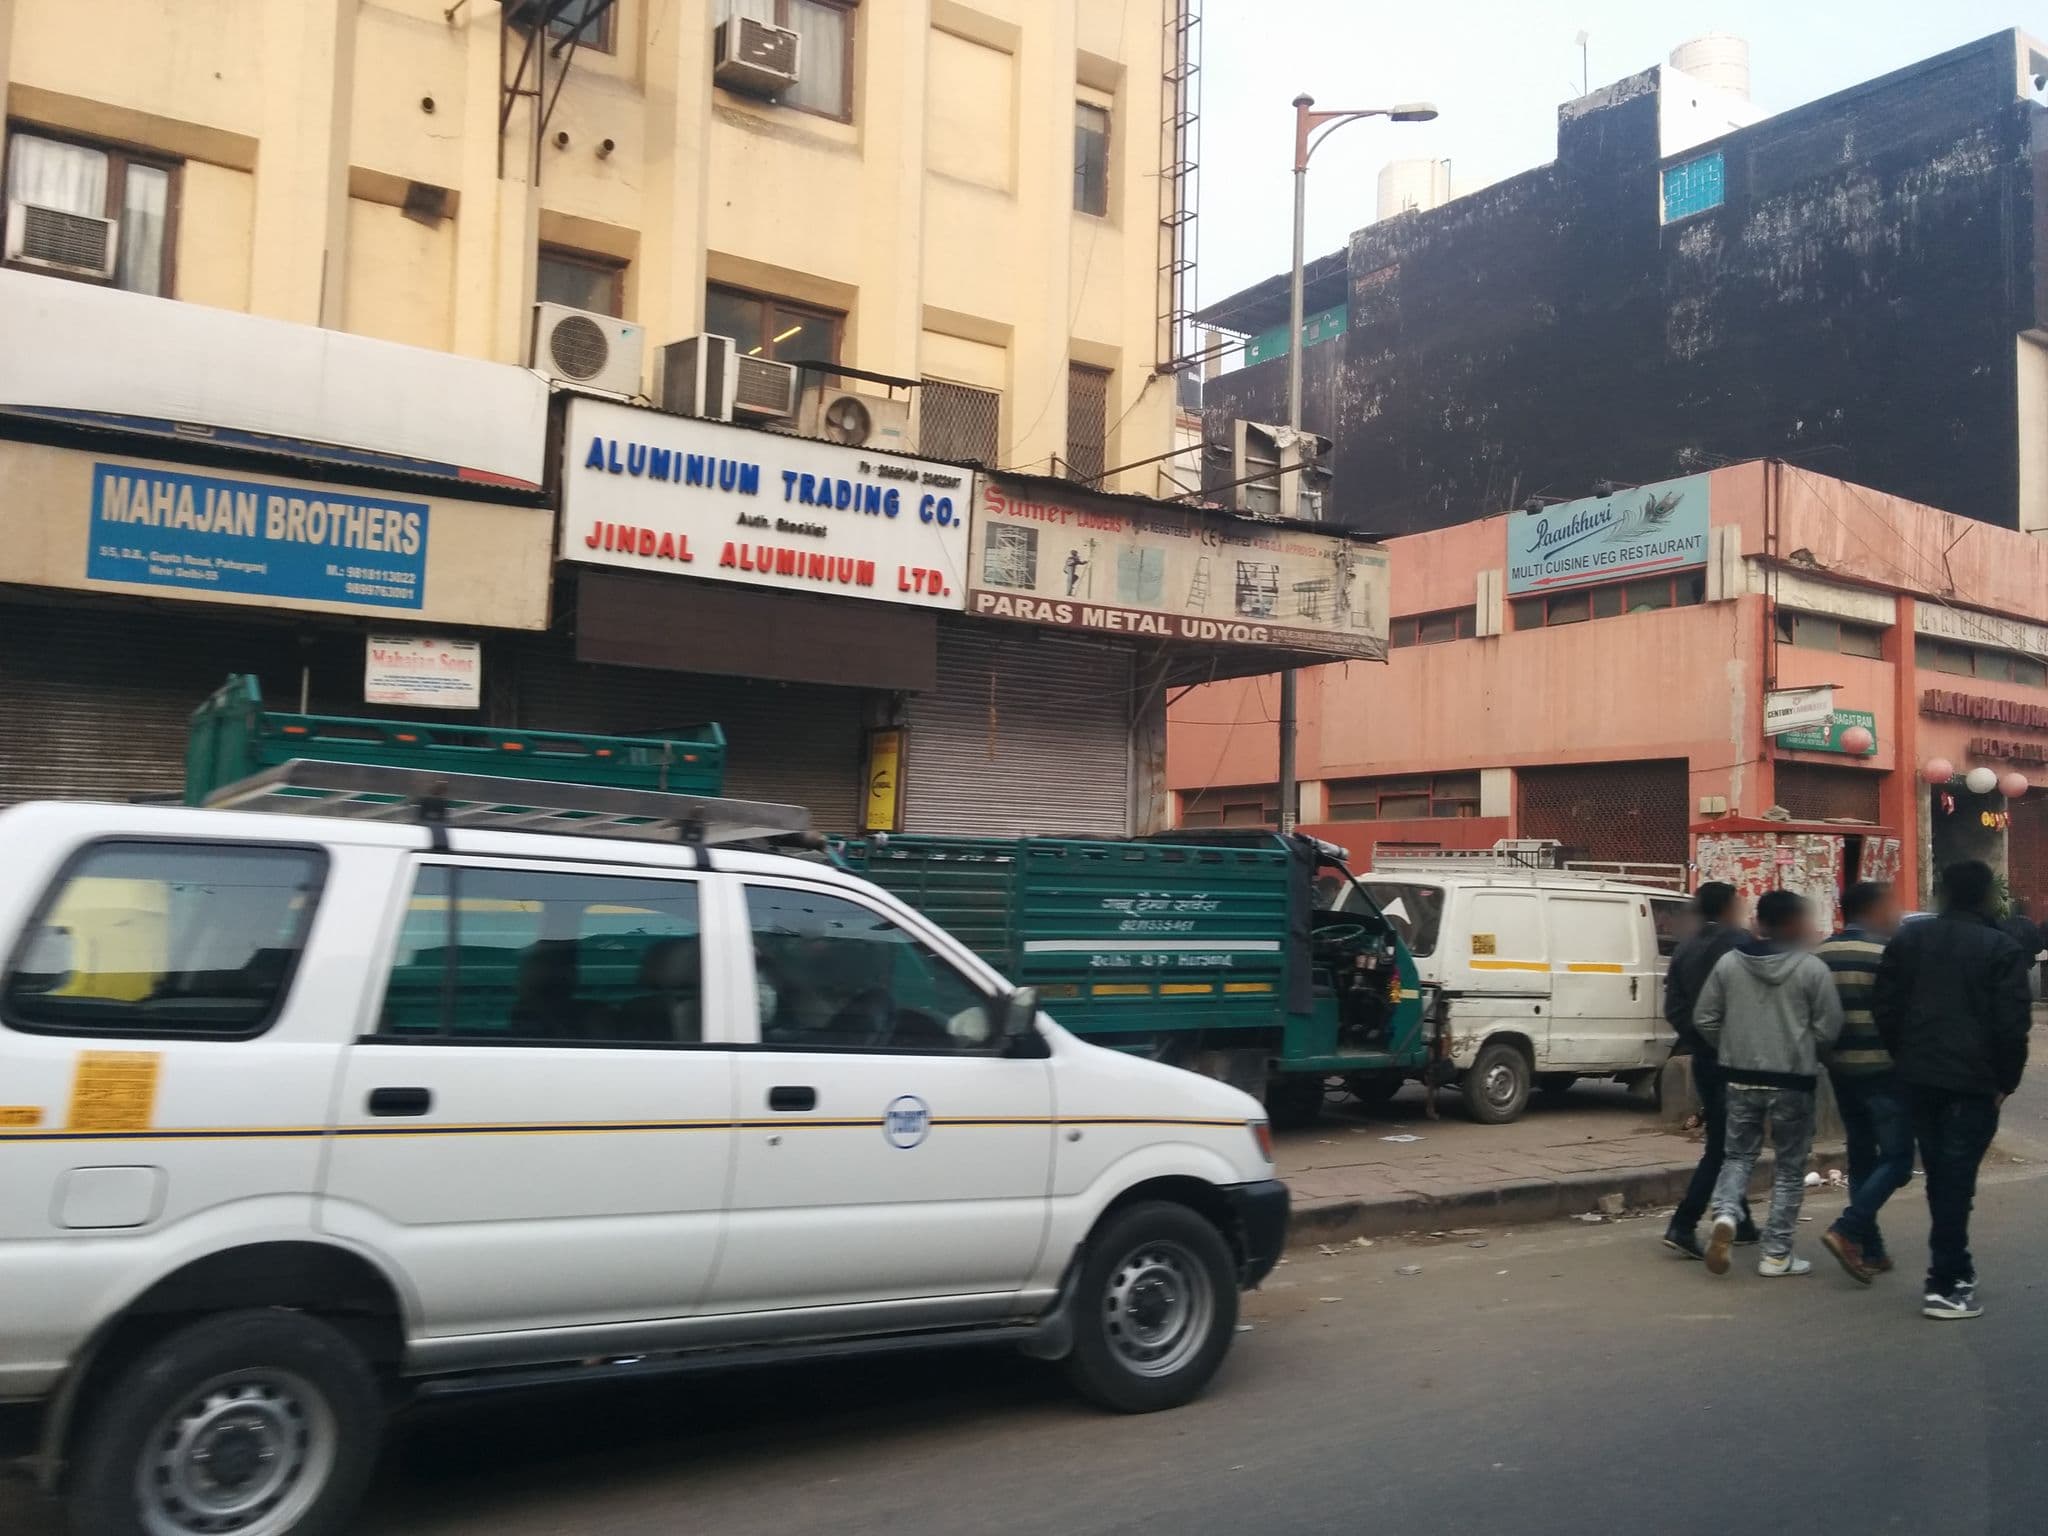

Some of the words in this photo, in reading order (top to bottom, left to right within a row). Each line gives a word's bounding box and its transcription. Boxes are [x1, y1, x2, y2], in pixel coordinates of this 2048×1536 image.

[585, 436, 760, 496] ALUMINIUM
[782, 469, 900, 518] TRADING
[919, 493, 961, 528] CO.
[101, 475, 257, 538] MAHAJAN
[265, 495, 421, 556] BROTHERS
[983, 484, 1074, 525] Sumer
[1078, 510, 1122, 534] LADDERS
[1526, 502, 1614, 552] Paankhuri
[585, 520, 694, 562] JINDAL
[719, 541, 876, 587] ALUMINIUM
[897, 565, 952, 597] LTD.
[1511, 563, 1543, 580] MULTI
[1545, 555, 1589, 574] CUISINE
[1592, 549, 1616, 566] VEG
[1620, 535, 1702, 561] RESTAURANT
[976, 593, 1074, 625] PARAS
[1082, 605, 1174, 636] METAL
[1181, 618, 1268, 643] UDYOG
[1767, 708, 1793, 719] CENTURY
